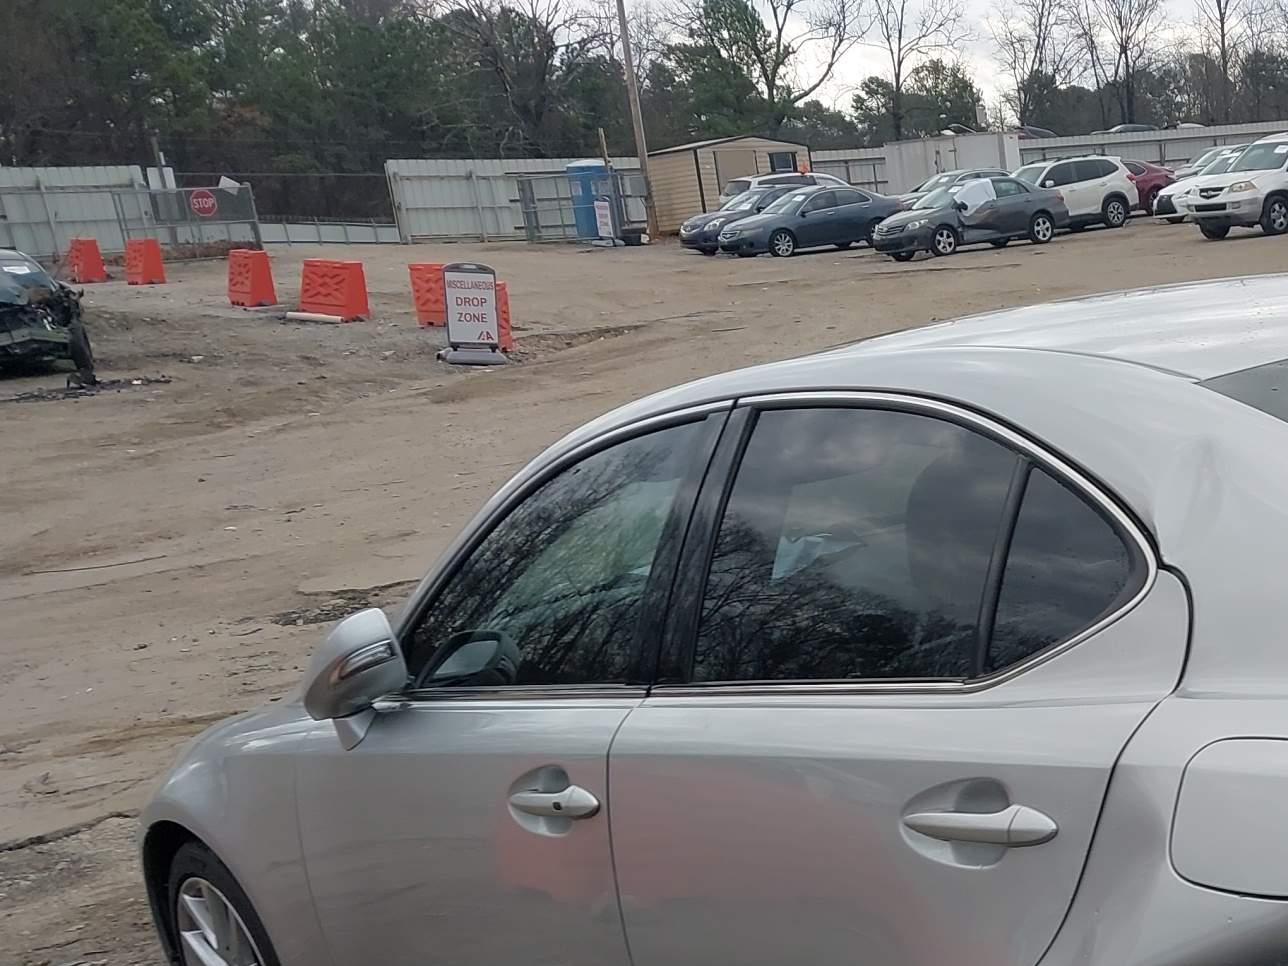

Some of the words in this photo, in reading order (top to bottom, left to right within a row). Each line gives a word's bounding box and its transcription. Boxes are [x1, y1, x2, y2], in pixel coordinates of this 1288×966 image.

[192, 197, 214, 209] STOP
[446, 279, 494, 290] MISCELLANEOUS
[455, 296, 488, 308] DROP
[457, 312, 489, 323] ZONE
